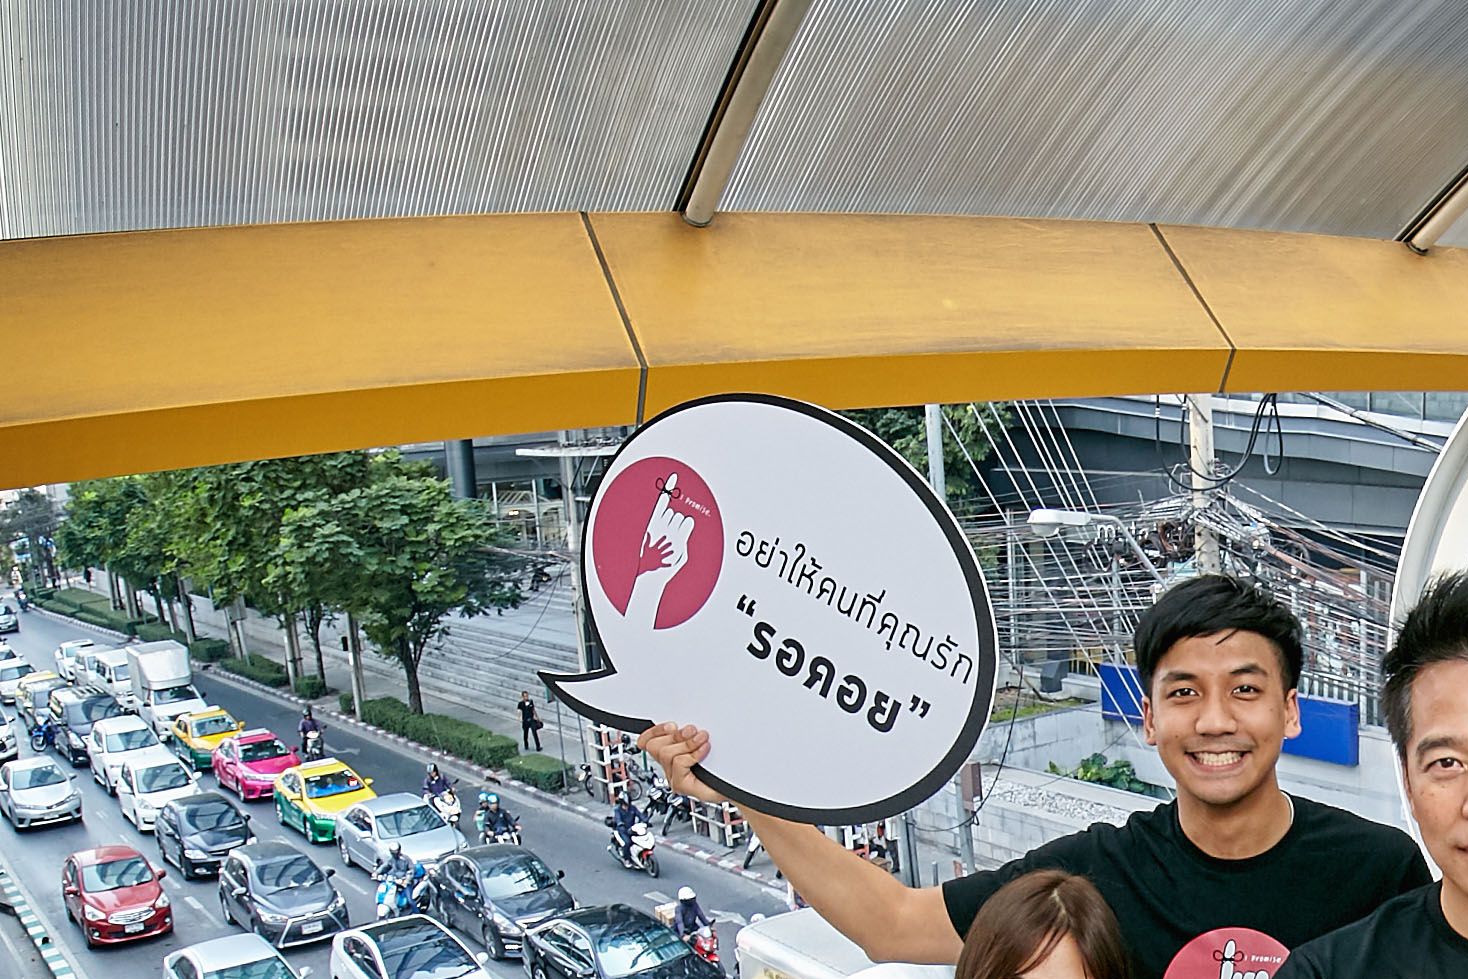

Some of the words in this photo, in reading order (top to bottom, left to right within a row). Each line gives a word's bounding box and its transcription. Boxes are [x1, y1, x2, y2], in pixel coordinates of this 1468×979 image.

[736, 529, 974, 685] อย่าให้คนที่คุณรัก
